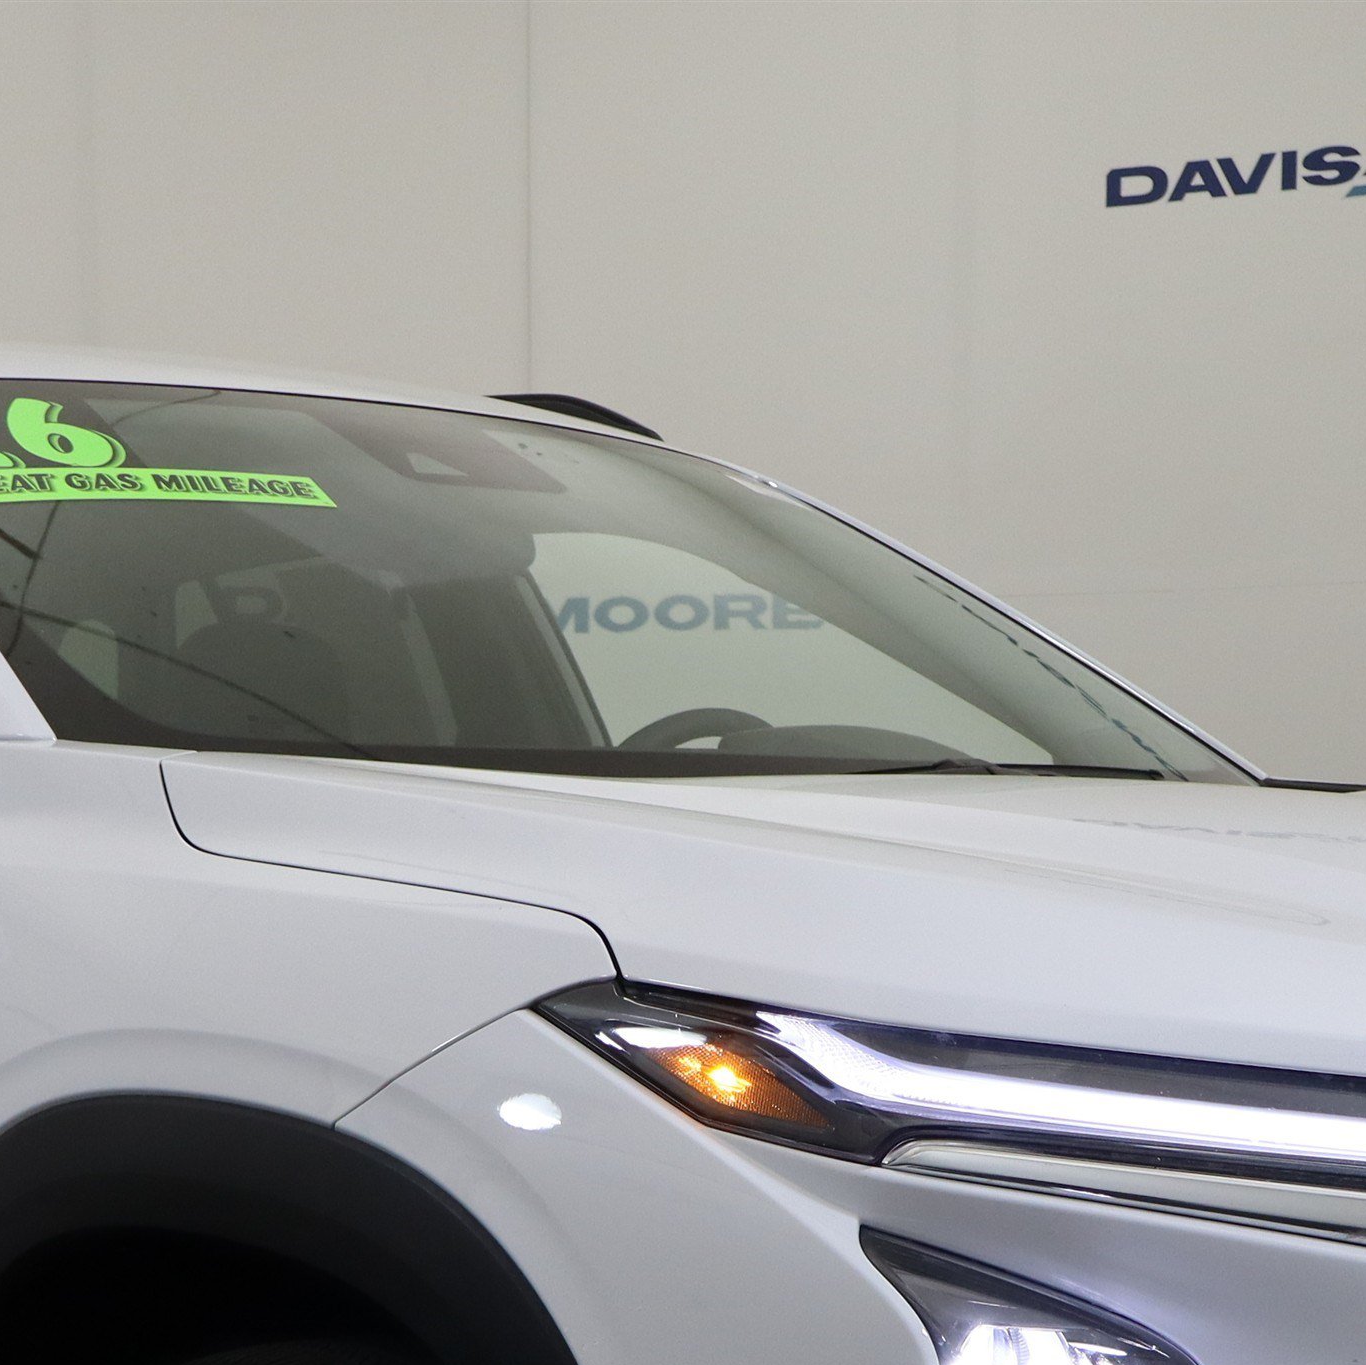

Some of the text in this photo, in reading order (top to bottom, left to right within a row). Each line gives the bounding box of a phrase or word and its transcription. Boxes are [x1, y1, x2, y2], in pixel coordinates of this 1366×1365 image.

[1105, 145, 1362, 208] DAVIS
[65, 472, 143, 491] GAS
[155, 472, 316, 499] MILEAGE
